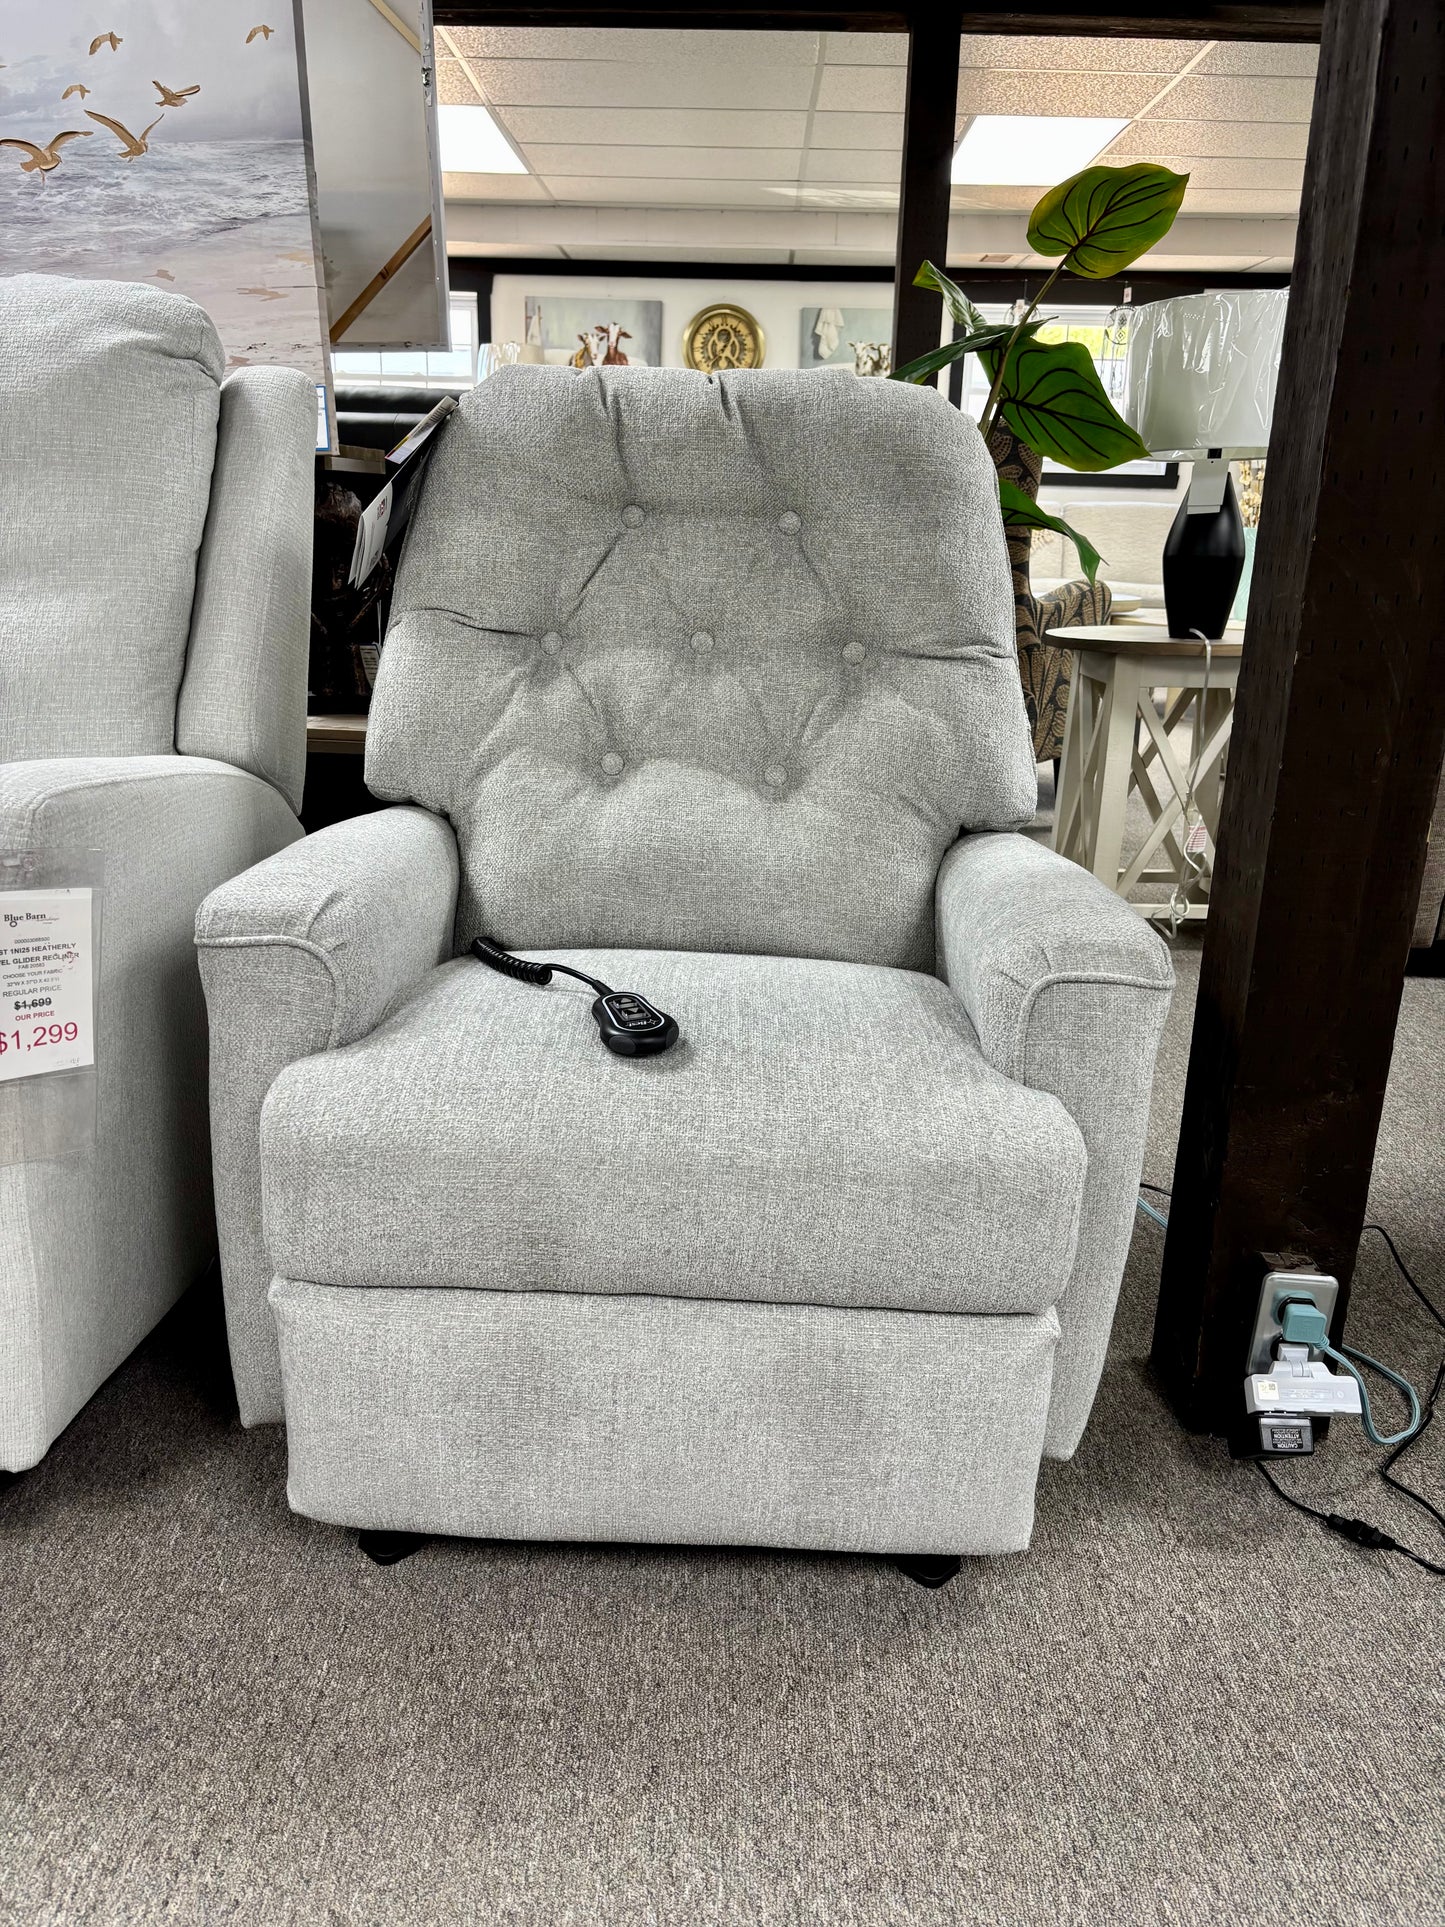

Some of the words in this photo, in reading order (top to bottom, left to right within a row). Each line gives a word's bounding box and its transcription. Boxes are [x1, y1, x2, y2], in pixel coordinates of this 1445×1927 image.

[4, 914, 24, 922] Blue
[26, 912, 46, 921] Barn
[31, 942, 77, 953] HEATHERLY
[12, 956, 41, 965] GLIDER
[42, 952, 80, 962] RECLINER
[2, 972, 26, 980] CHOOSE
[2, 987, 38, 998] REGULAR
[39, 985, 63, 993] PRICE
[14, 997, 52, 1011] $1,699
[15, 1013, 32, 1021] OUR
[33, 1010, 55, 1019] PRICE
[0, 1021, 79, 1056] $1,299
